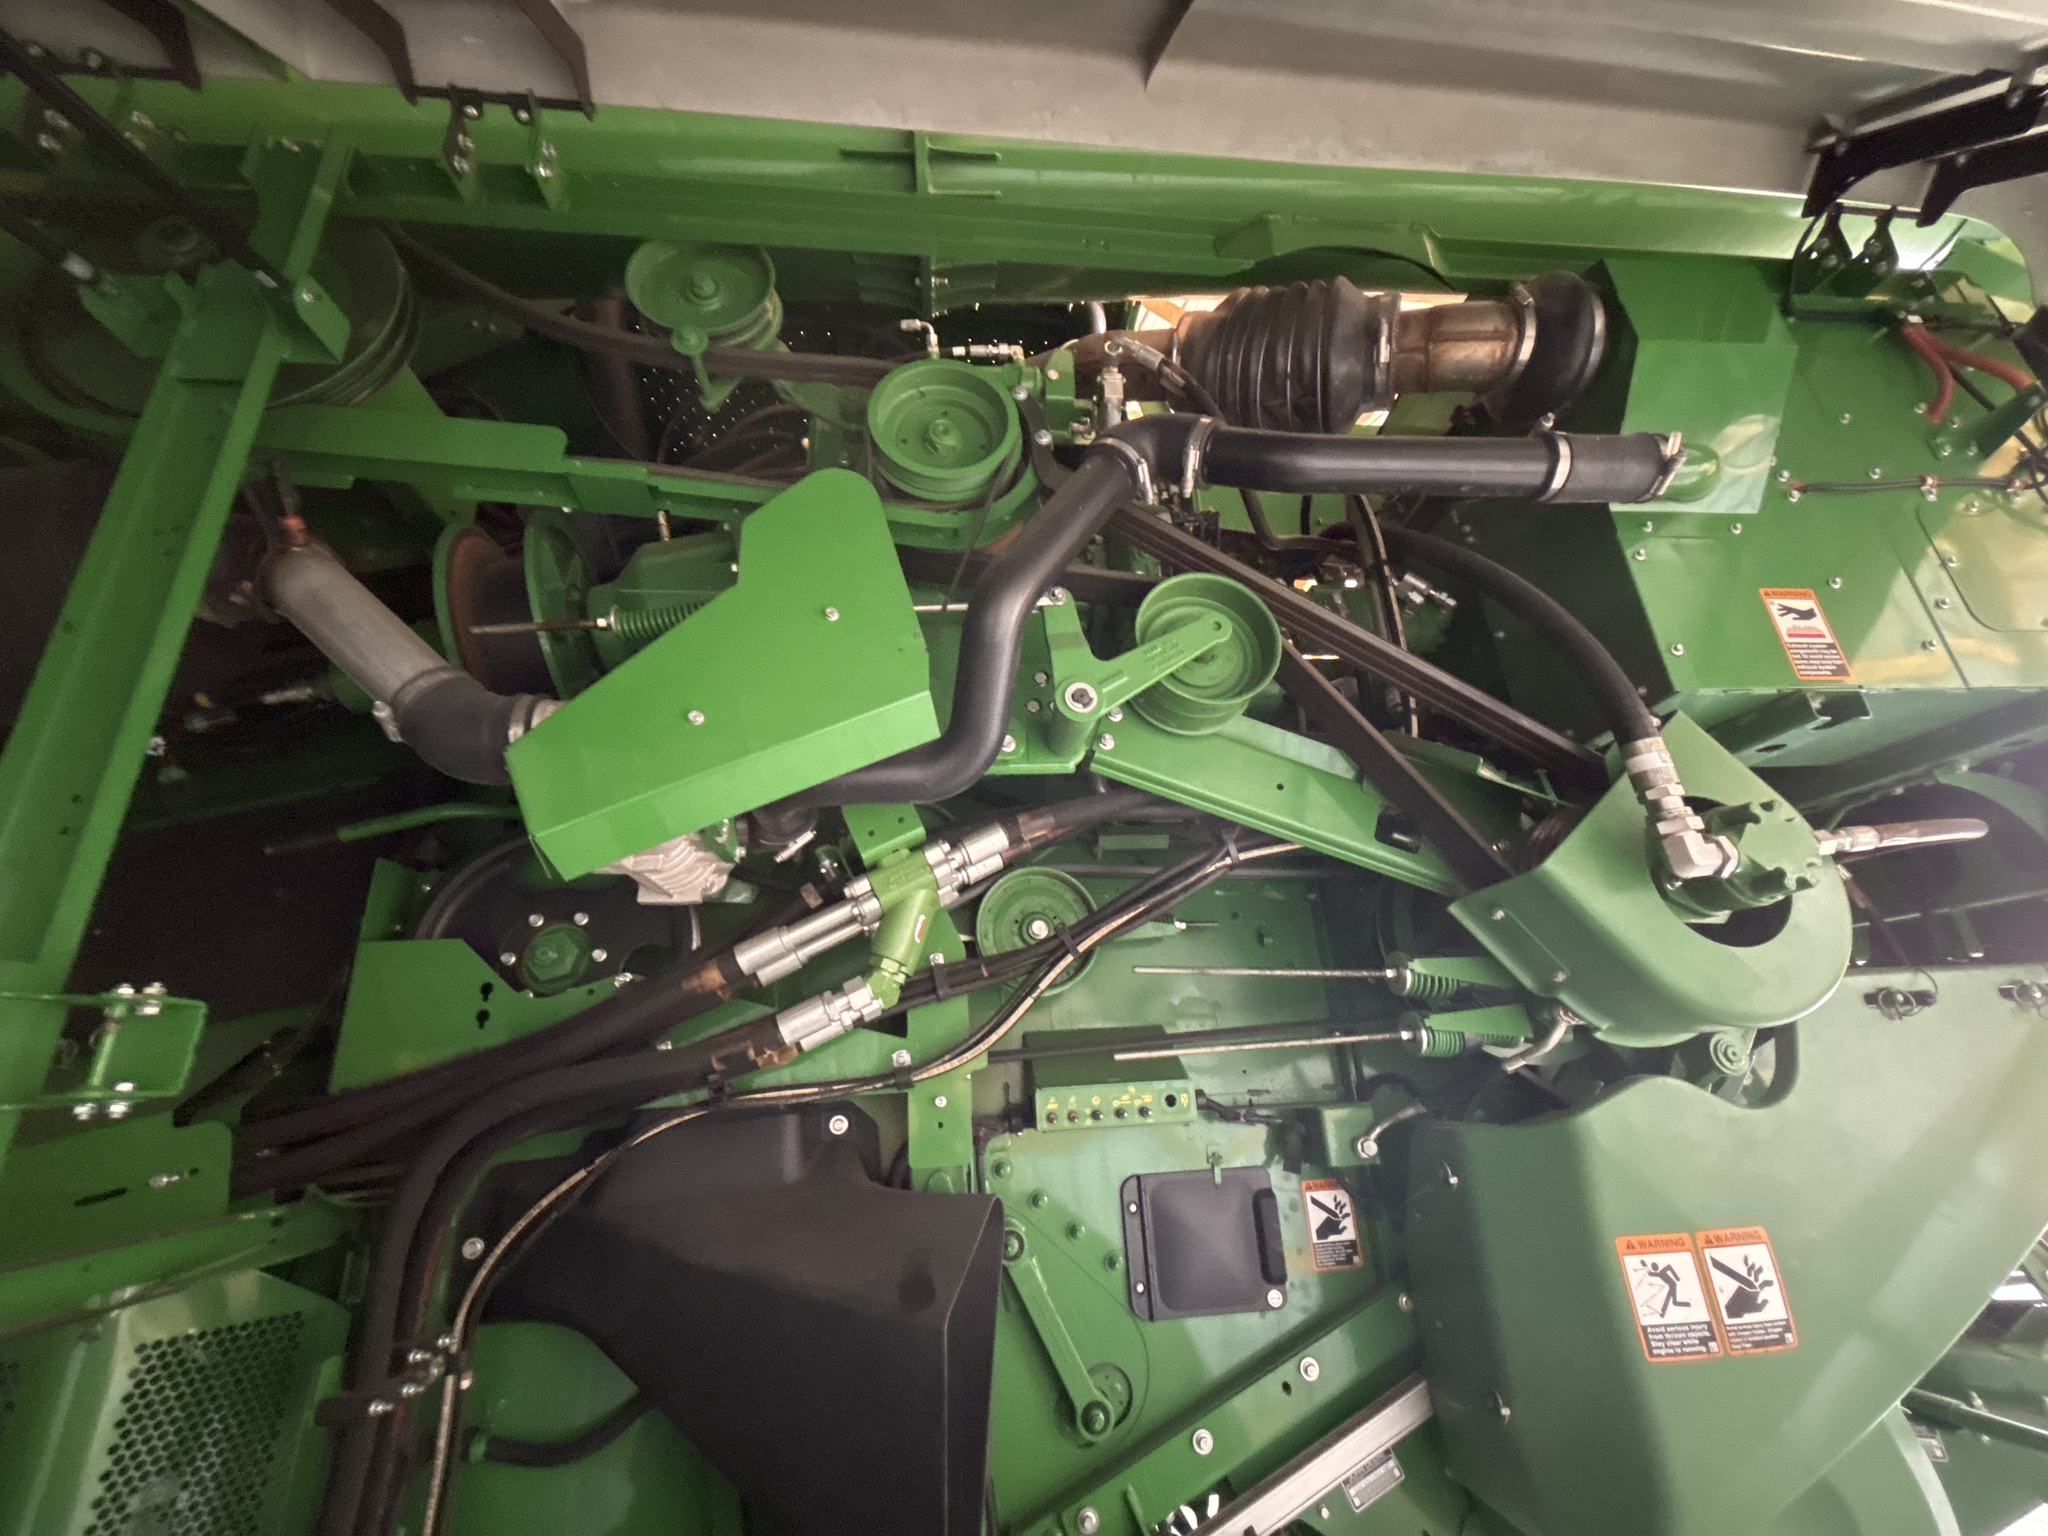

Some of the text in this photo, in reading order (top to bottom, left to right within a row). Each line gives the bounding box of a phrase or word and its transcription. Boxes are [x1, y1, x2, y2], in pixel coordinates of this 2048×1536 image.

[1713, 1230, 1762, 1244] WARNING
[1638, 1237, 1686, 1249] WARNING
[1647, 1323, 1708, 1333] Avoid serious injury
[1664, 1332, 1687, 1340] thrown
[1650, 1340, 1666, 1348] Stay
[1652, 1348, 1675, 1356] engine
